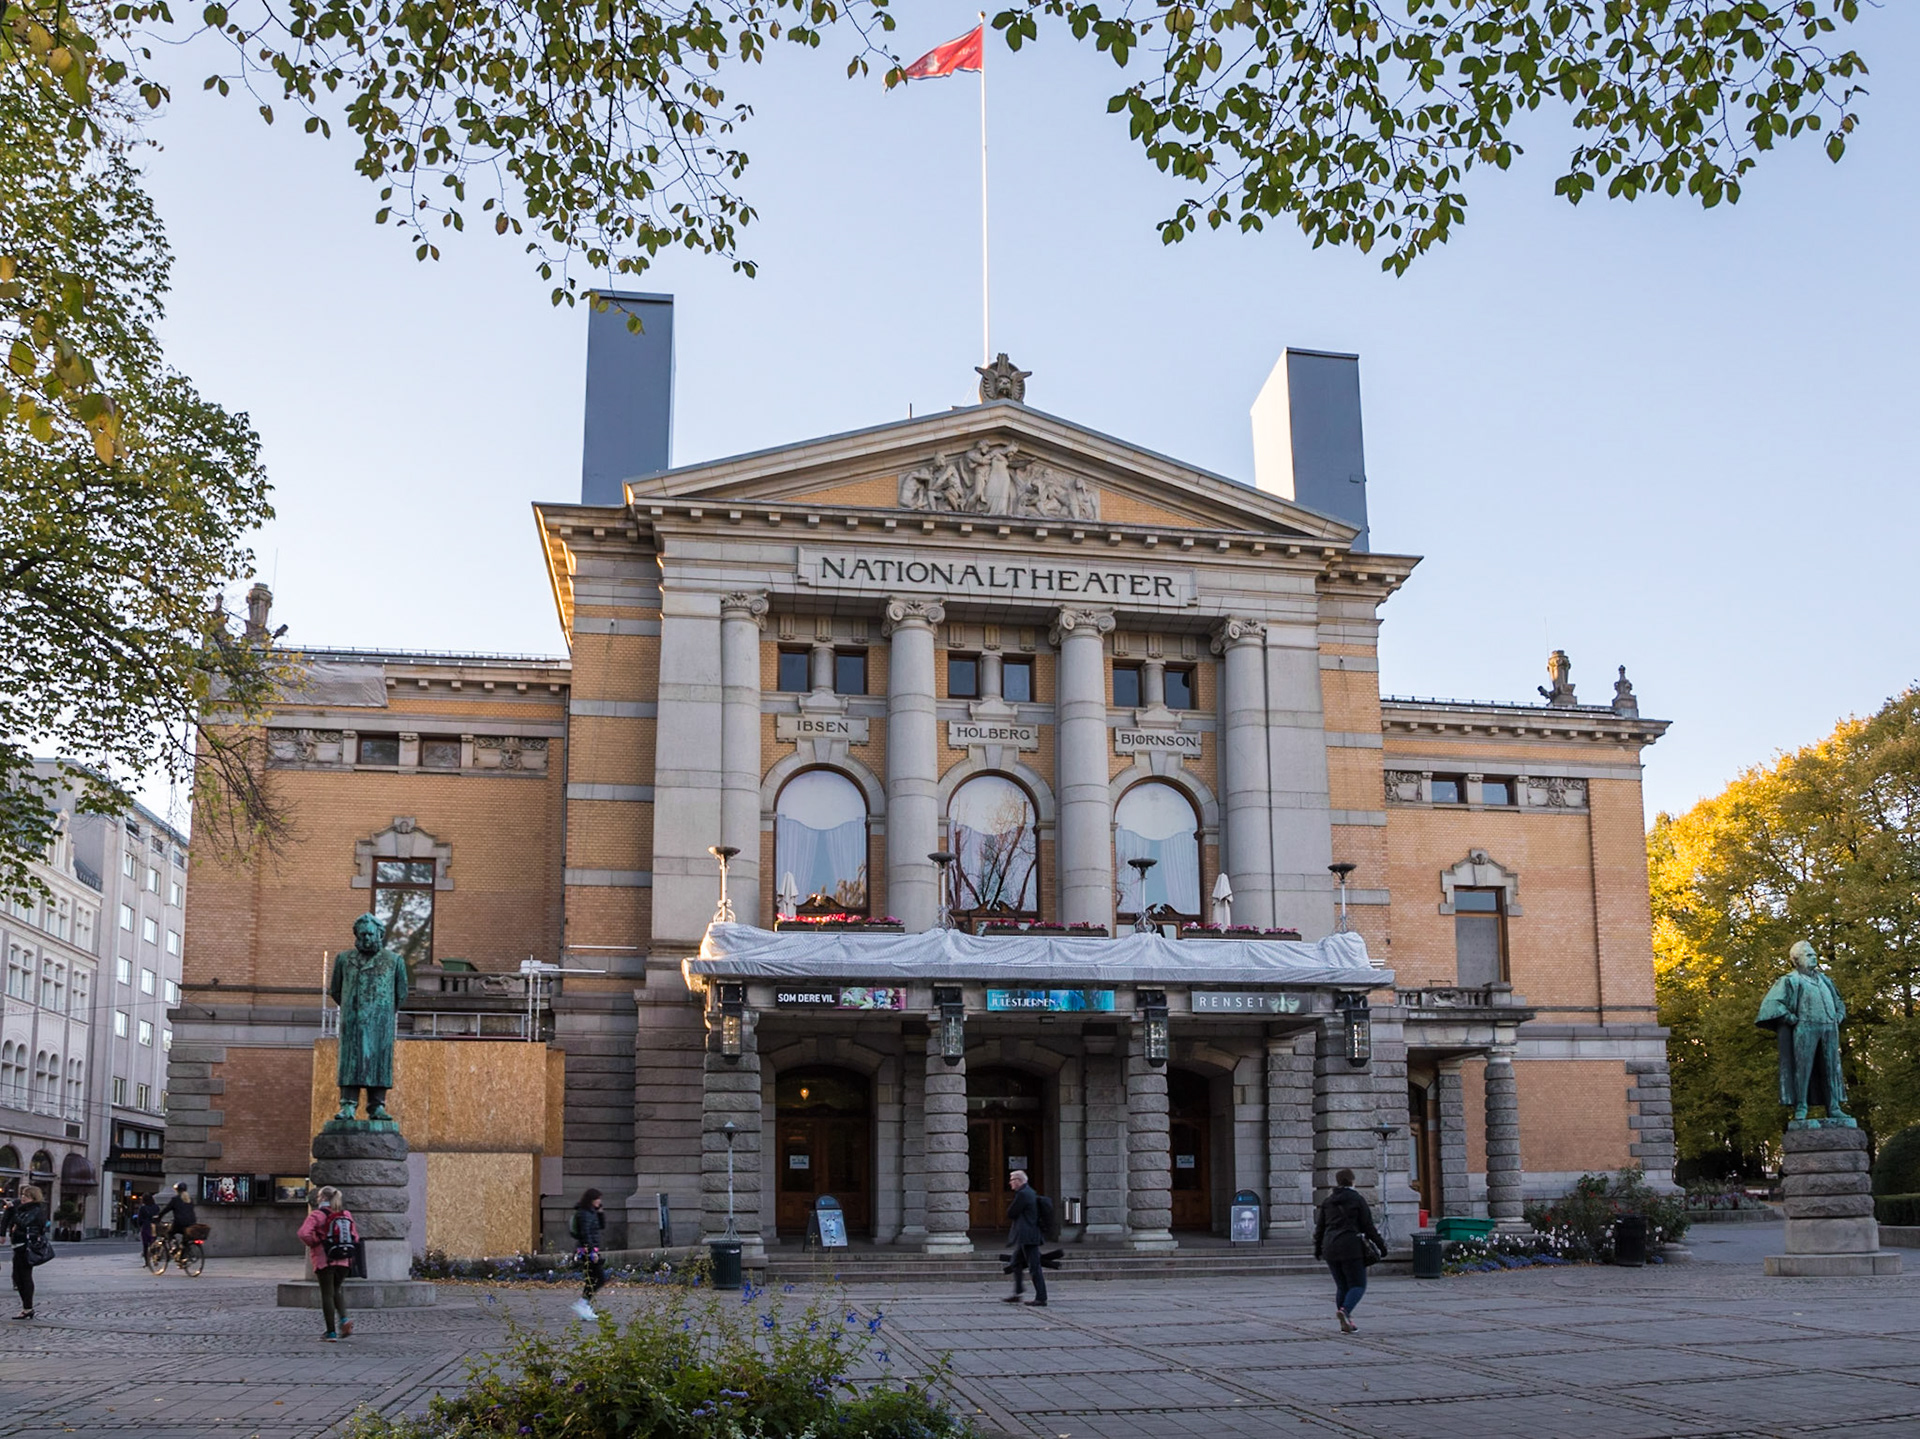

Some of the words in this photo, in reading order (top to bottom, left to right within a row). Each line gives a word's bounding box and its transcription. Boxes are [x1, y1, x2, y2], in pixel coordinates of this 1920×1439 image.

[821, 557, 1175, 598] NATIONALTHEATER
[797, 720, 849, 733] IBSEN
[957, 727, 1030, 740] HOLBERG
[1121, 734, 1197, 747] BJØRNSON
[777, 993, 797, 1003] SOM
[797, 993, 820, 1003] DERE
[821, 994, 835, 1003] VIL
[990, 997, 1056, 1008] JULESTJERNEN
[1199, 996, 1264, 1008] RENSET
